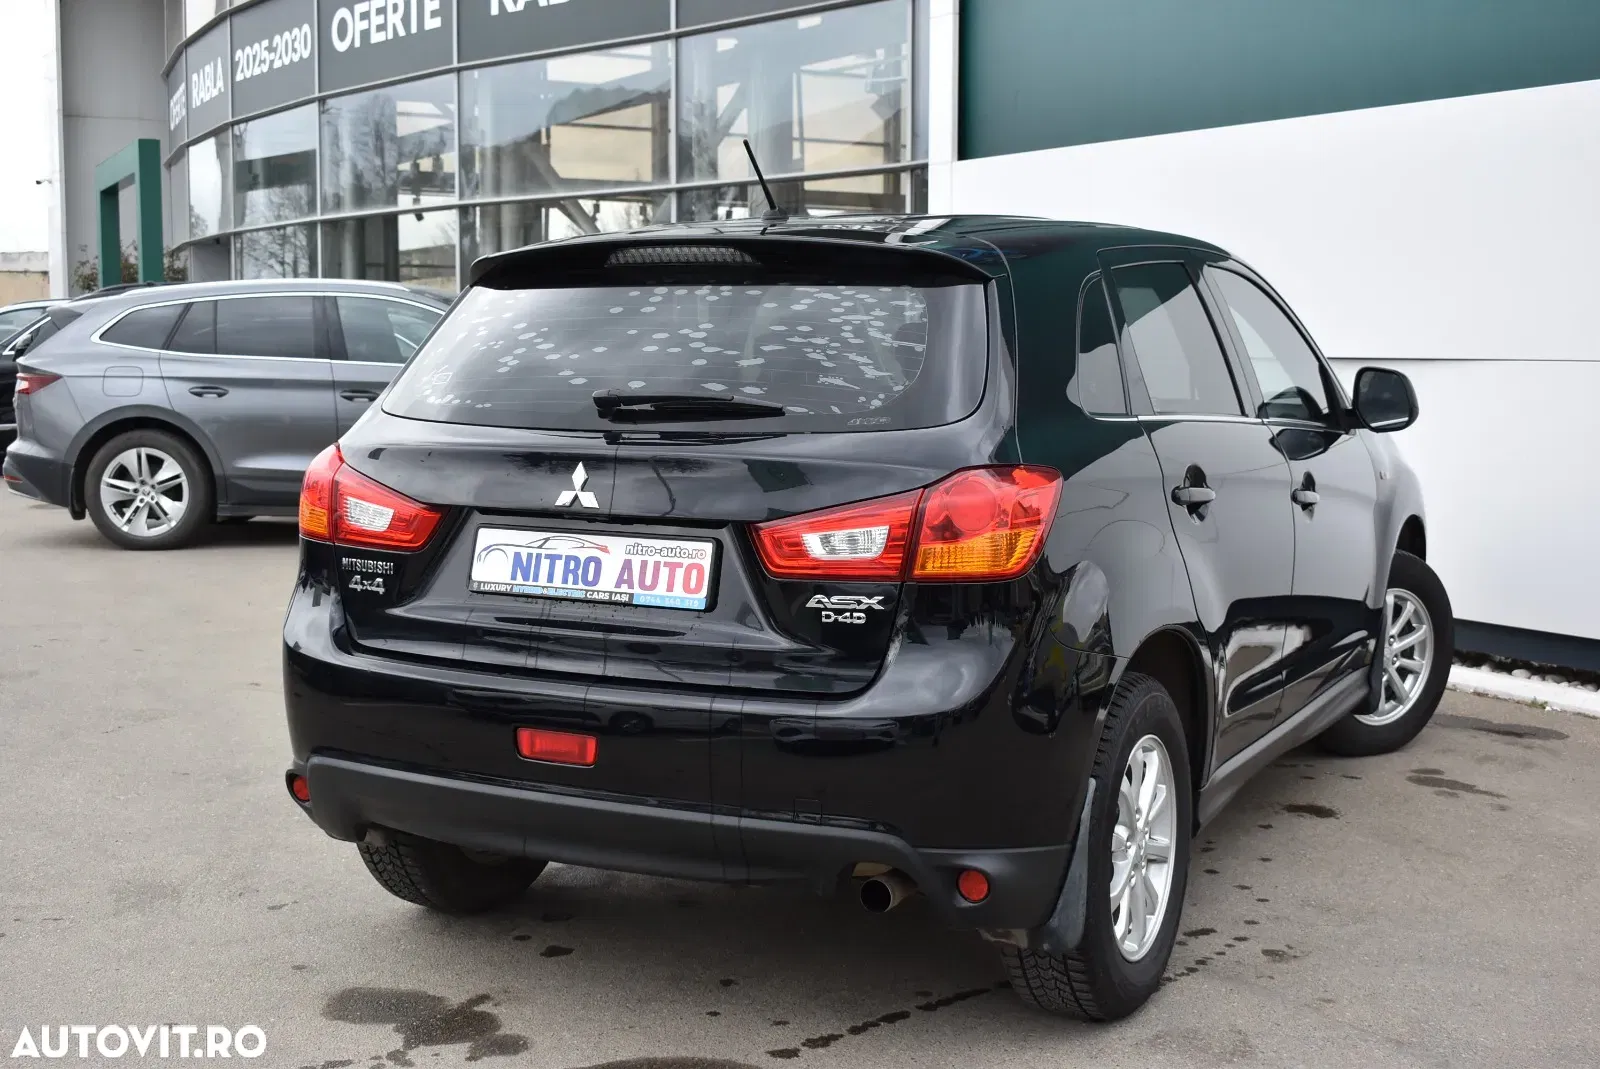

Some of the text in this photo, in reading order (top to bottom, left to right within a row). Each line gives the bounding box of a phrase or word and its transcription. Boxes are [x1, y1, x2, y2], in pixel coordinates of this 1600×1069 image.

[331, 0, 442, 52] OFERTE
[235, 23, 311, 82] 2025-2030
[191, 57, 225, 109] RABLA
[625, 543, 707, 560] nitro-auto.ro
[342, 557, 394, 575] MITSUBISHI
[510, 551, 705, 595] NITRO AUTO
[348, 575, 386, 595] 4x4
[480, 582, 512, 592] LUXURY
[587, 591, 610, 600] CARS
[805, 594, 885, 610] ASX
